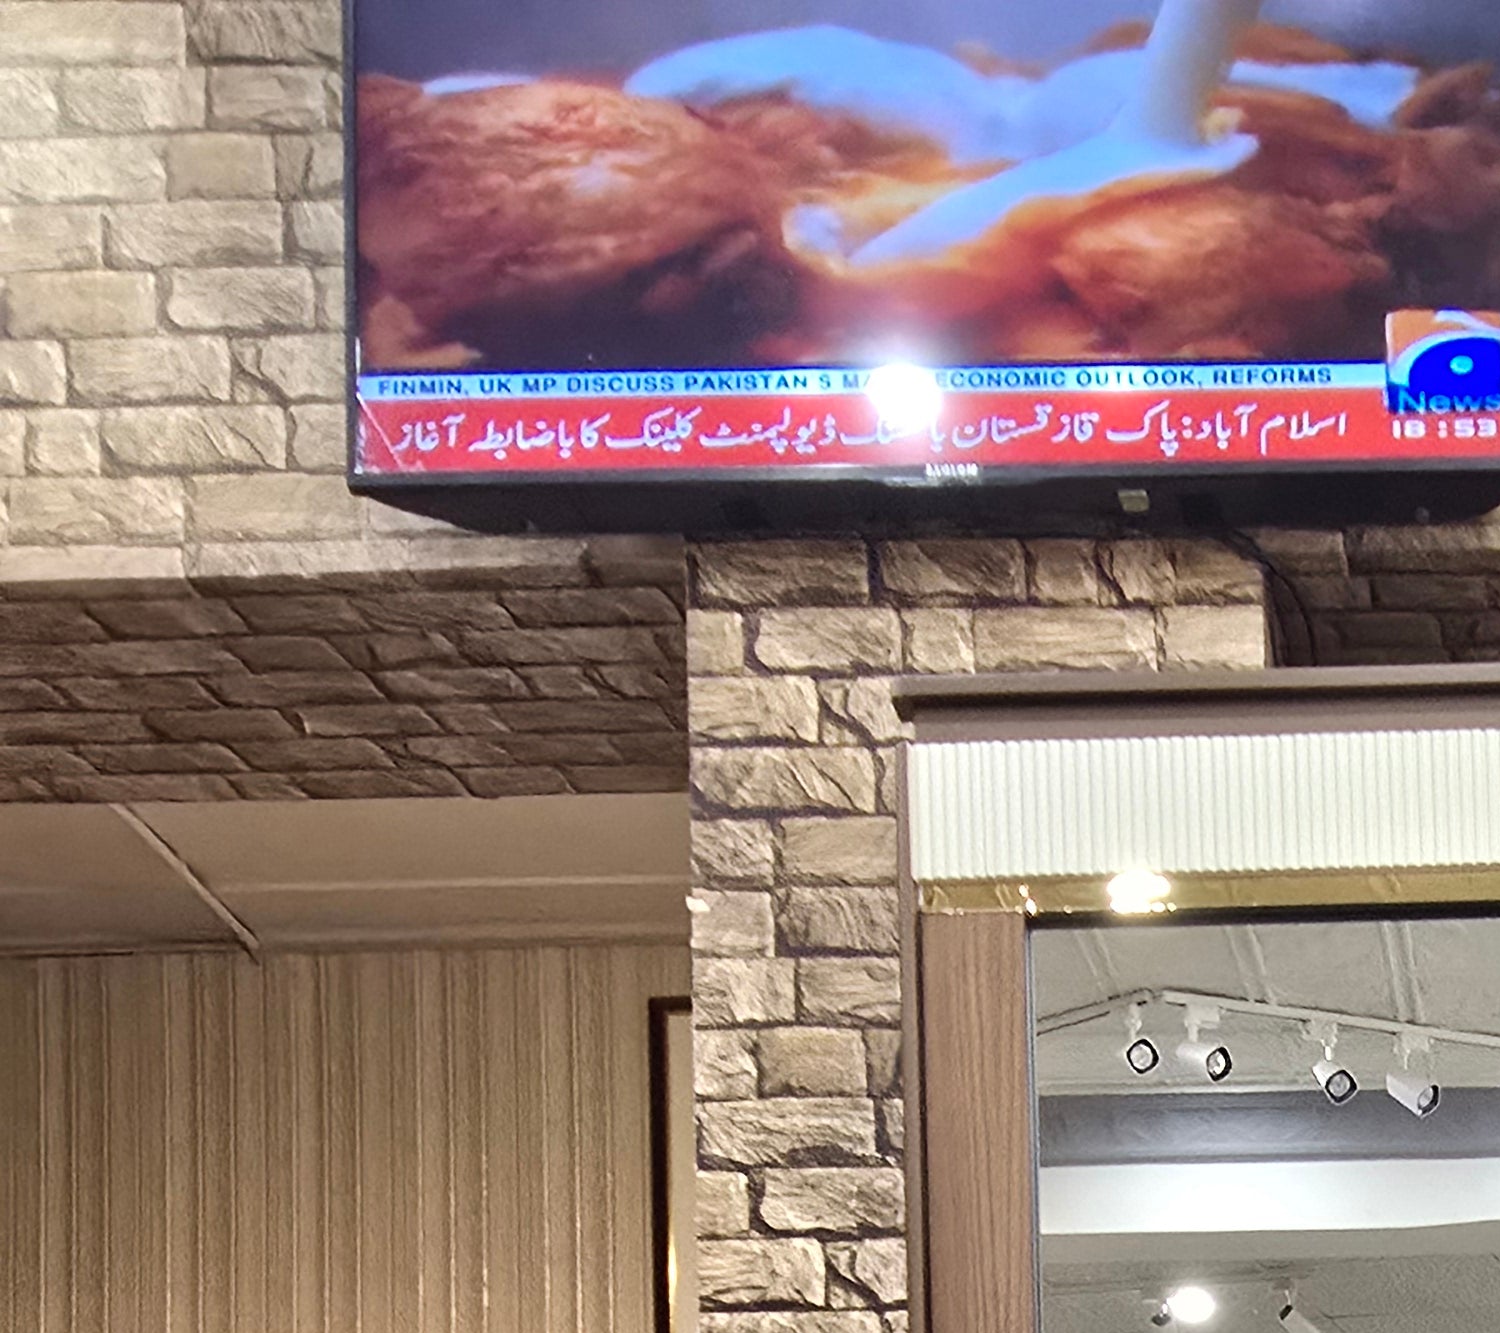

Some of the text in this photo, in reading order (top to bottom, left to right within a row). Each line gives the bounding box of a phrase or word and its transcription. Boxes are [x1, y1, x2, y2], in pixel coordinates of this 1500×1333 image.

[377, 378, 469, 396] FINMIN,
[479, 377, 512, 393] UK
[522, 376, 557, 393] MP
[566, 374, 674, 393] DISCUSS
[684, 372, 808, 390] PAKISTAN
[818, 373, 833, 390] S
[1076, 369, 1202, 389] OUTLOOK,
[1212, 366, 1332, 385] REFORMS
[390, 412, 468, 453] آغاز
[580, 412, 612, 450] کا
[604, 405, 703, 453] کلینک
[1259, 410, 1347, 456] اسلام
[1391, 417, 1497, 440] 18:53
